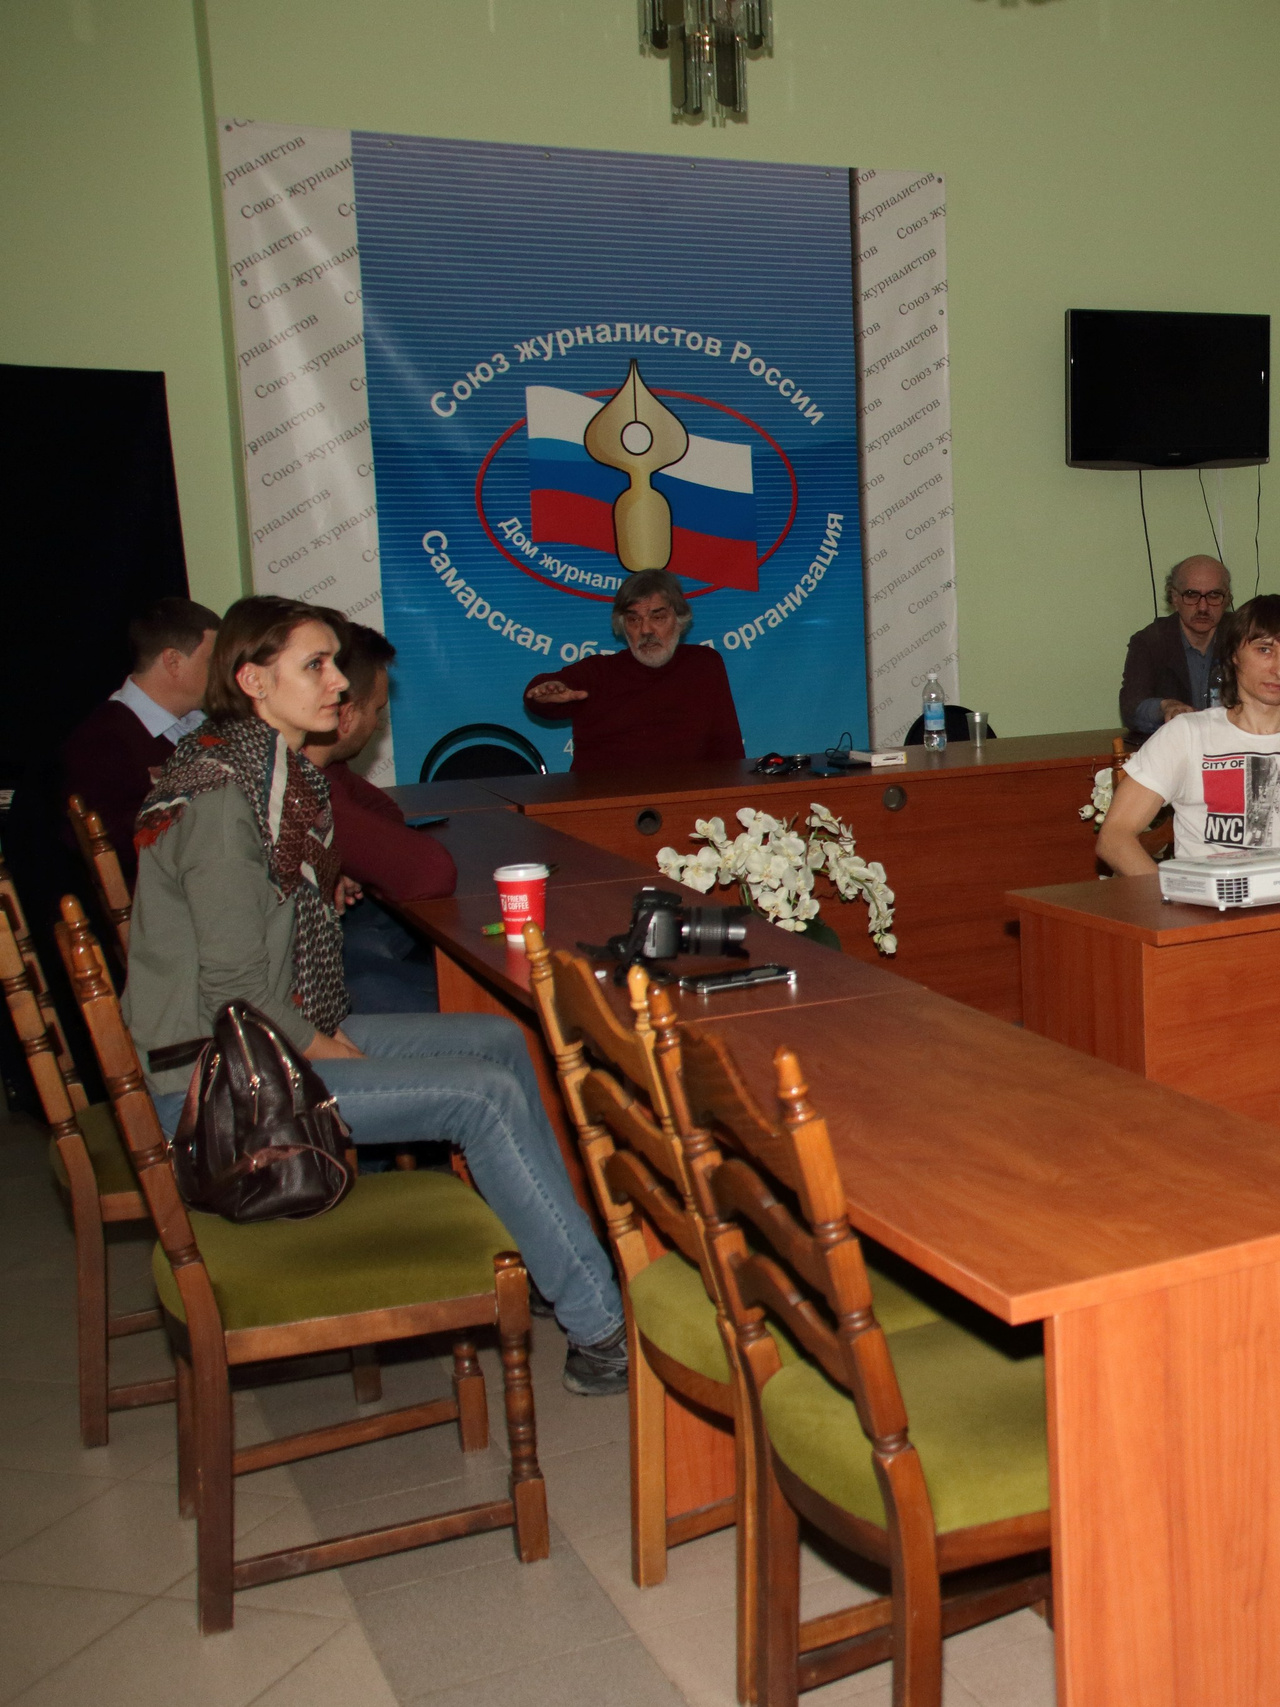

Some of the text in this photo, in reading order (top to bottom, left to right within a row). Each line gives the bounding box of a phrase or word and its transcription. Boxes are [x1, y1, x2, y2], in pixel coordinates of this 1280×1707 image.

[240, 193, 283, 219] Союз
[859, 172, 935, 224] журналистов
[896, 216, 929, 240] Союз
[861, 248, 937, 301] журналистов
[248, 282, 291, 310] Союз
[898, 292, 930, 316] Союз
[863, 324, 938, 378] журналистов
[254, 371, 297, 399] Союз
[430, 323, 825, 426] Союз журналистов России
[901, 367, 932, 391] Союз
[865, 399, 941, 453] журналистов
[903, 442, 934, 466] Союз
[261, 459, 303, 487] Союз
[868, 473, 943, 529] журналистов
[497, 516, 539, 559] Дом
[905, 517, 937, 541] Союз
[268, 546, 309, 574] Союз
[422, 529, 553, 656] Самарская
[722, 513, 844, 650] организация
[872, 547, 945, 603] журналистов
[908, 590, 939, 615] Союз
[874, 621, 948, 678] журналистов
[1202, 760, 1244, 769] CITY OF
[1206, 816, 1243, 841] NYC
[508, 902, 530, 910] COFFEE
